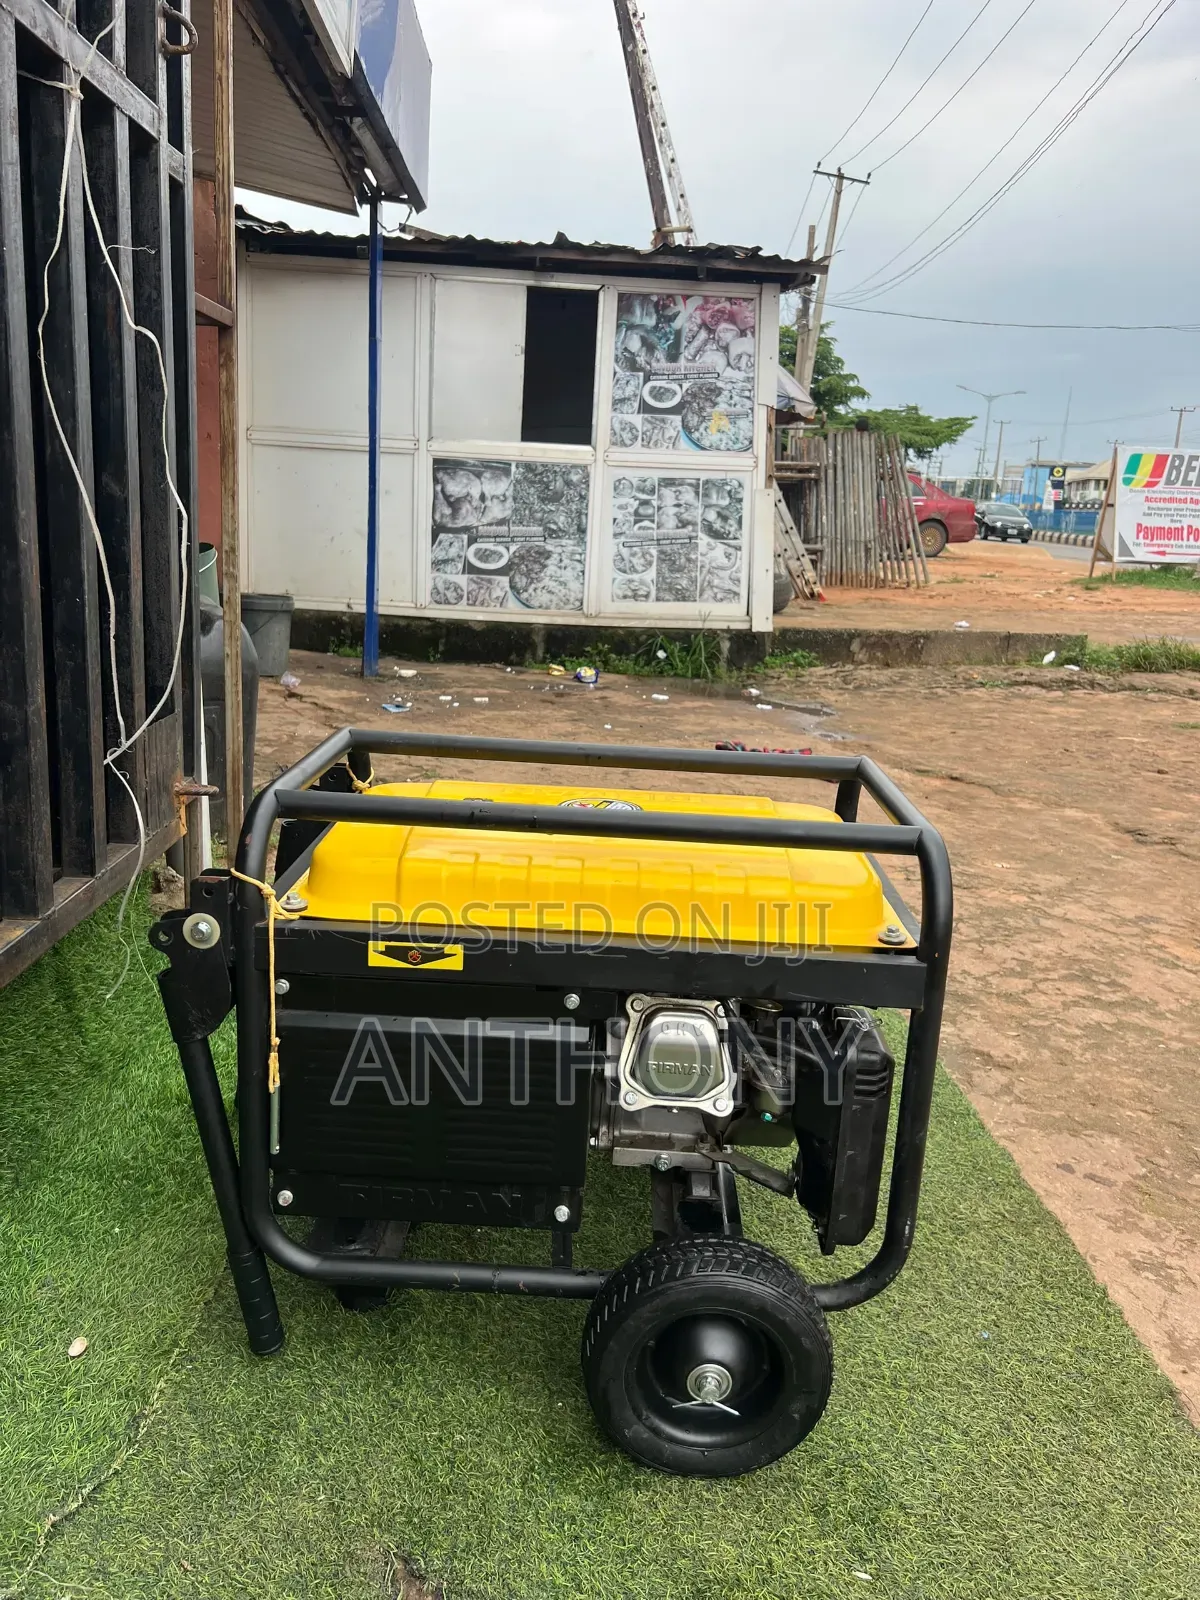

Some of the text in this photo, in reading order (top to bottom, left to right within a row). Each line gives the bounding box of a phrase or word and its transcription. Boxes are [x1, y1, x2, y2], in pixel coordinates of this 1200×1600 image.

[1144, 496, 1188, 504] Accredited
[1136, 523, 1184, 542] Payment
[646, 1060, 714, 1076] FIRMAN
